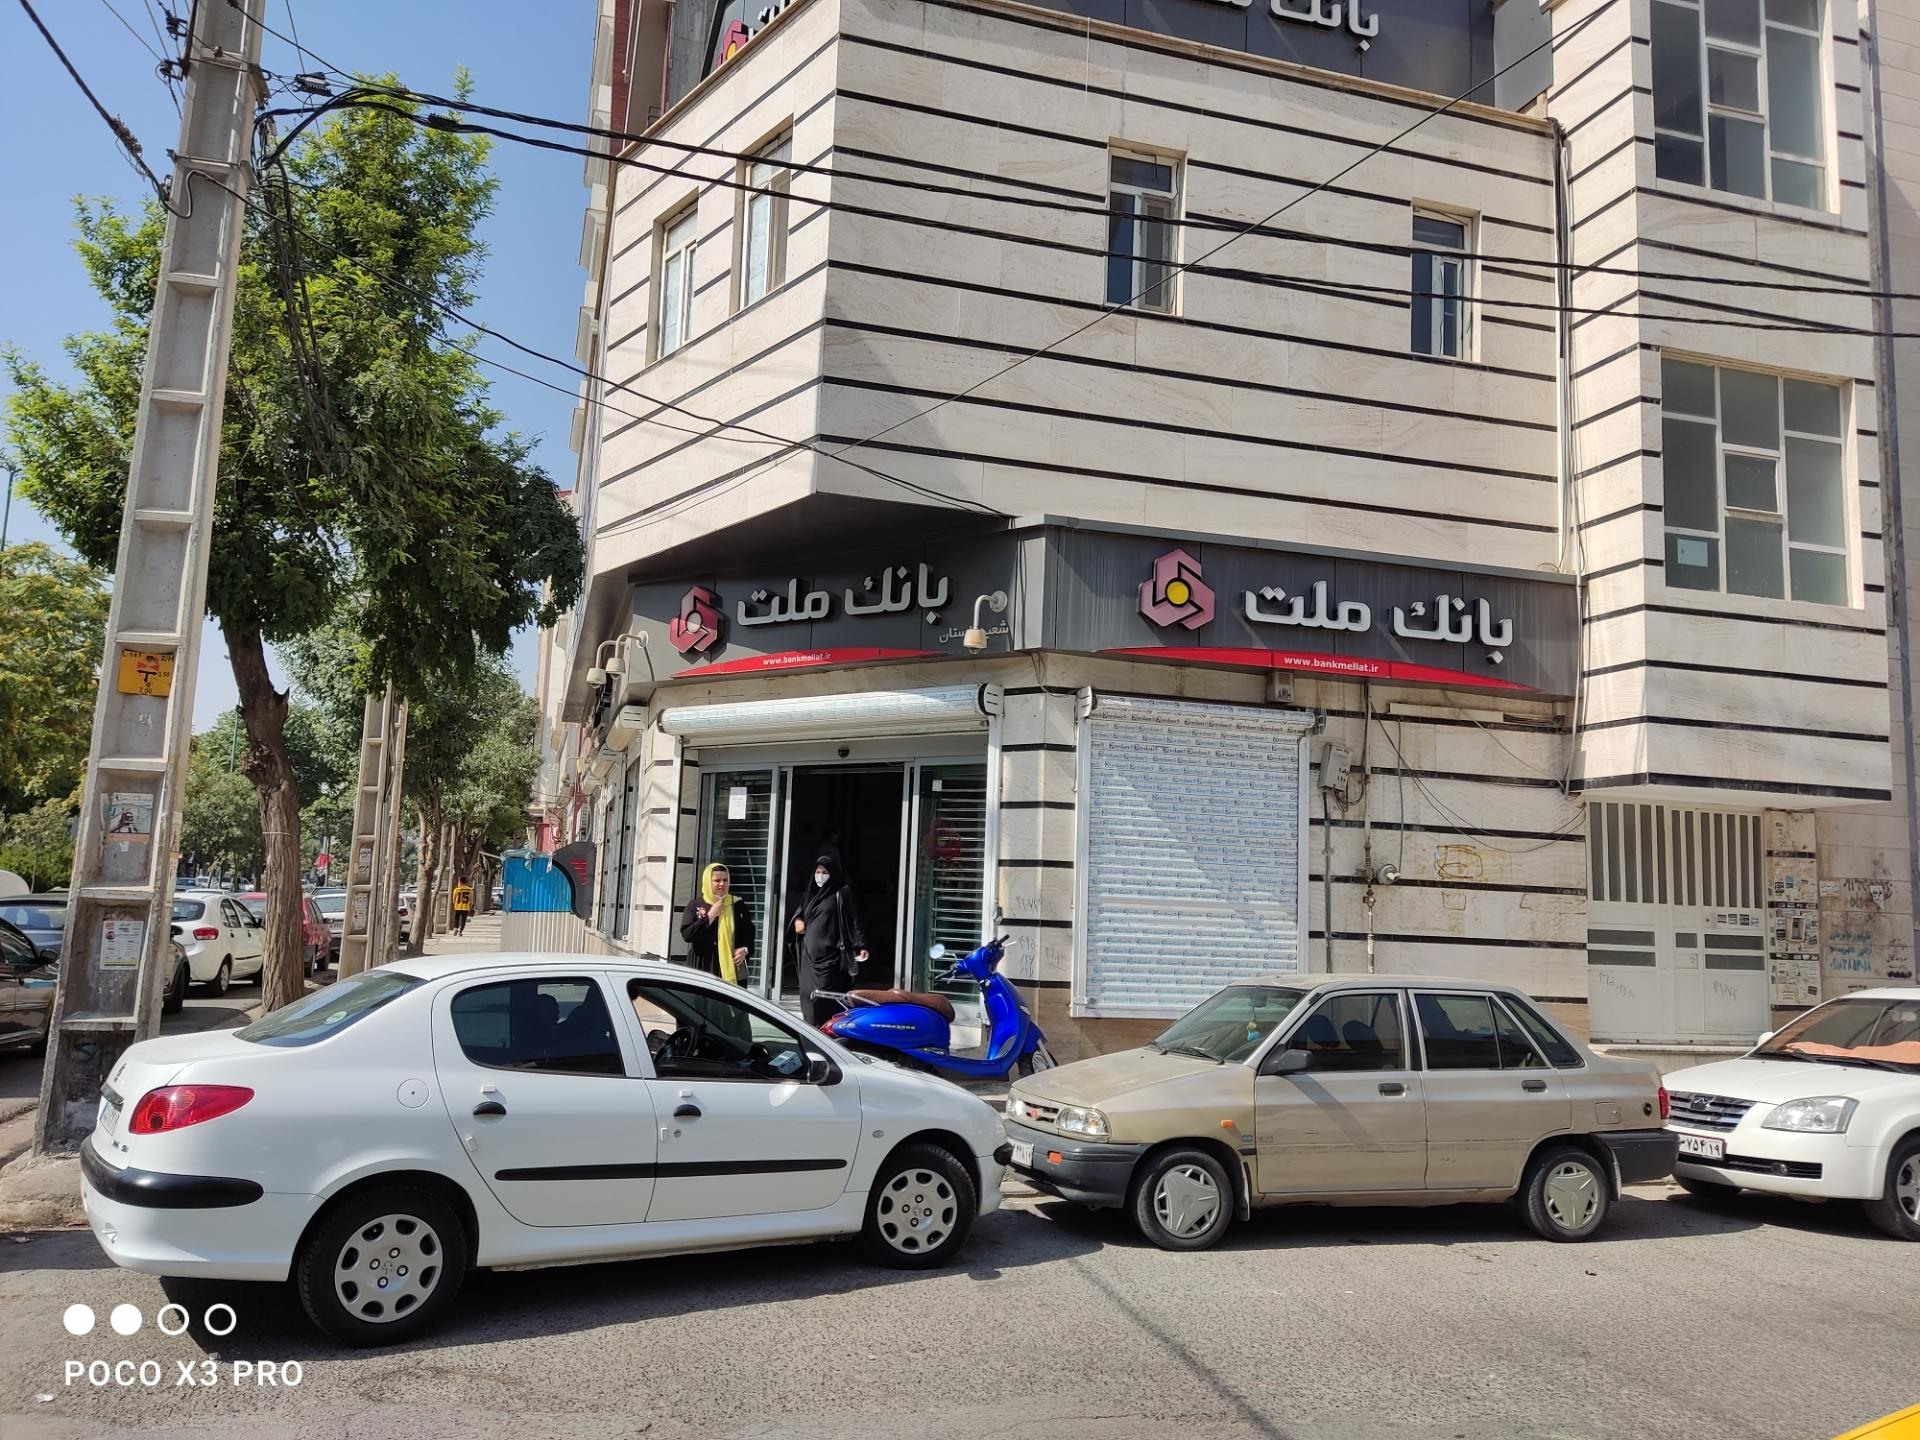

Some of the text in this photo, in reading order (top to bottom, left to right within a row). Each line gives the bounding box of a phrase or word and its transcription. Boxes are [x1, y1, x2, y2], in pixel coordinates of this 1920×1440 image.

[738, 578, 830, 625] ملت
[1242, 580, 1372, 633] ملت
[1284, 656, 1379, 672] www.bankmellat.ir
